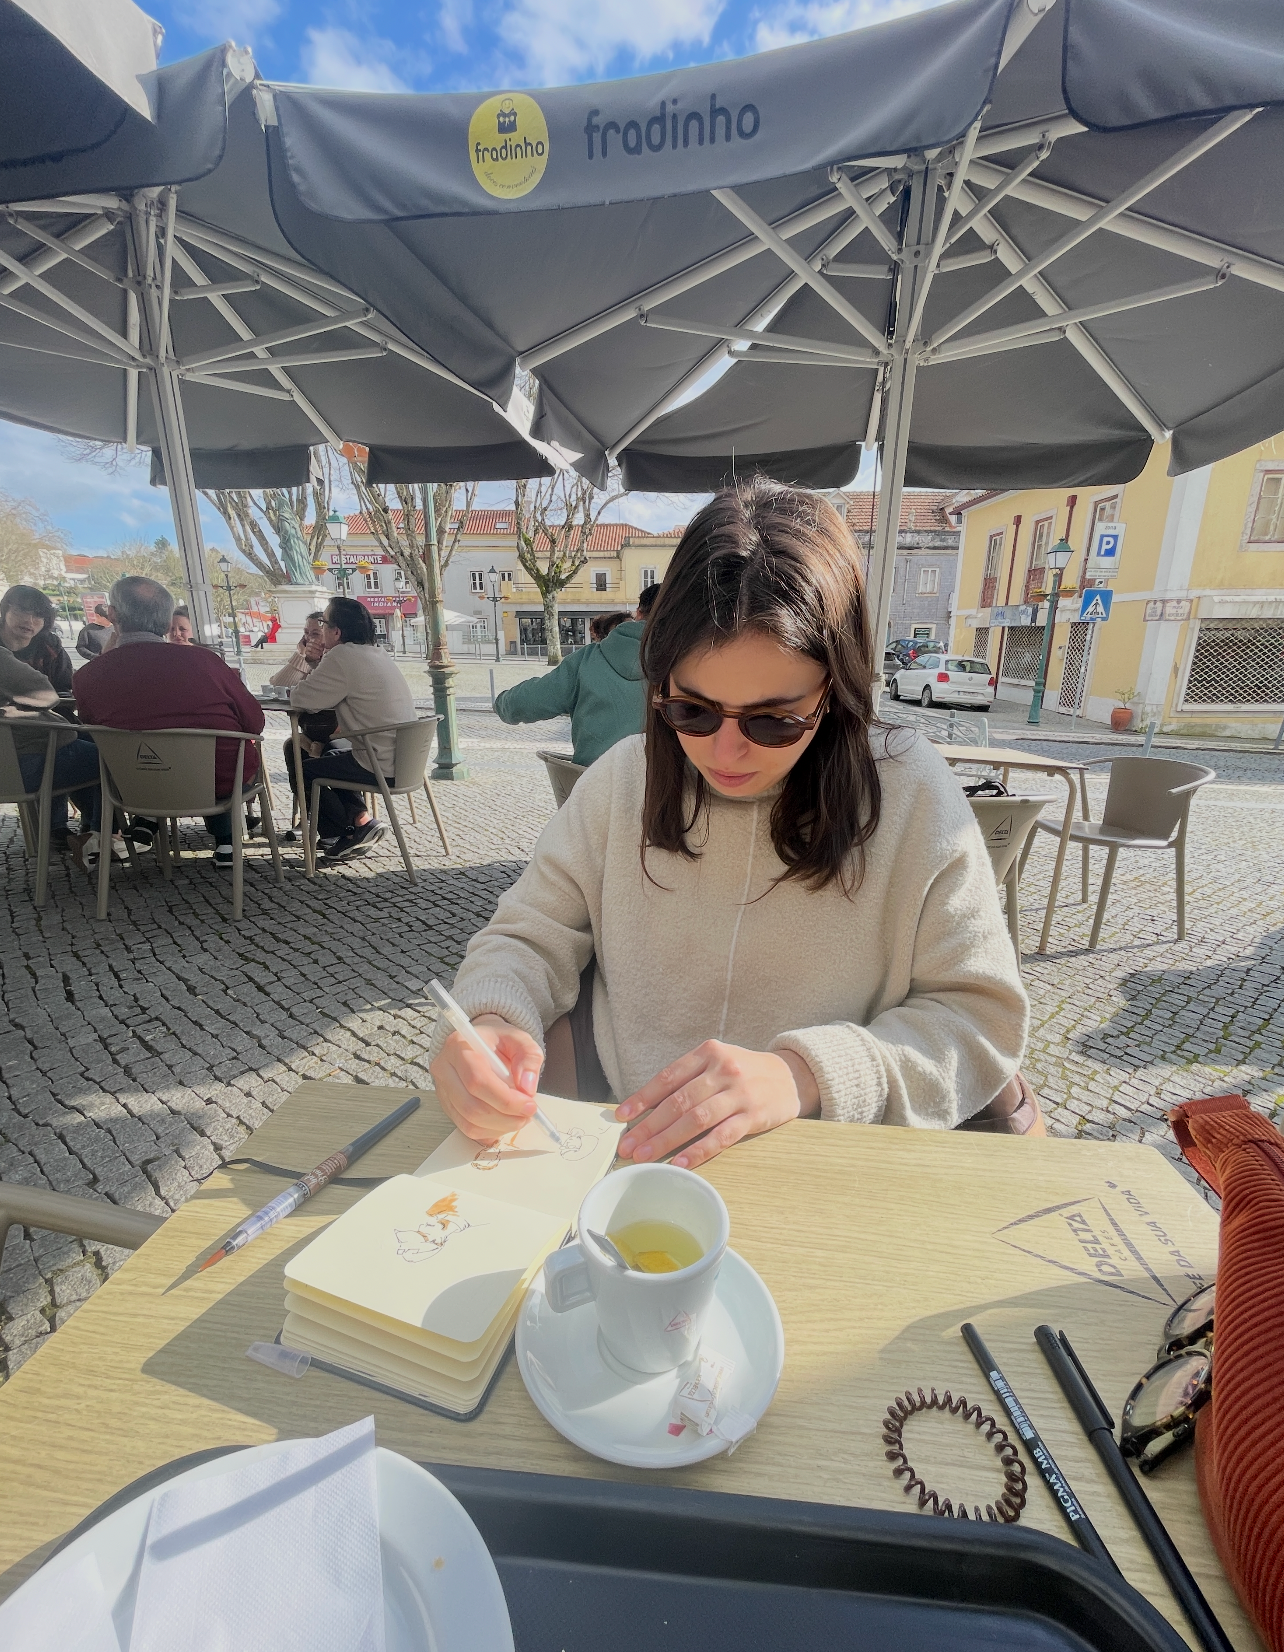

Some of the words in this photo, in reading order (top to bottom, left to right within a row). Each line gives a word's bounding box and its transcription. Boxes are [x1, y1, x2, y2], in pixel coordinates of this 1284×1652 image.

[584, 92, 761, 161] fradinho
[474, 136, 545, 164] fradinho
[1100, 536, 1115, 555] P
[1121, 1189, 1151, 1218] VIDA
[1063, 1212, 1125, 1278] DELTA
[1145, 1221, 1176, 1247] SUA
[1169, 1250, 1195, 1269] DA
[1033, 1447, 1051, 1470] MB
[1048, 1473, 1081, 1521] PIGMA
